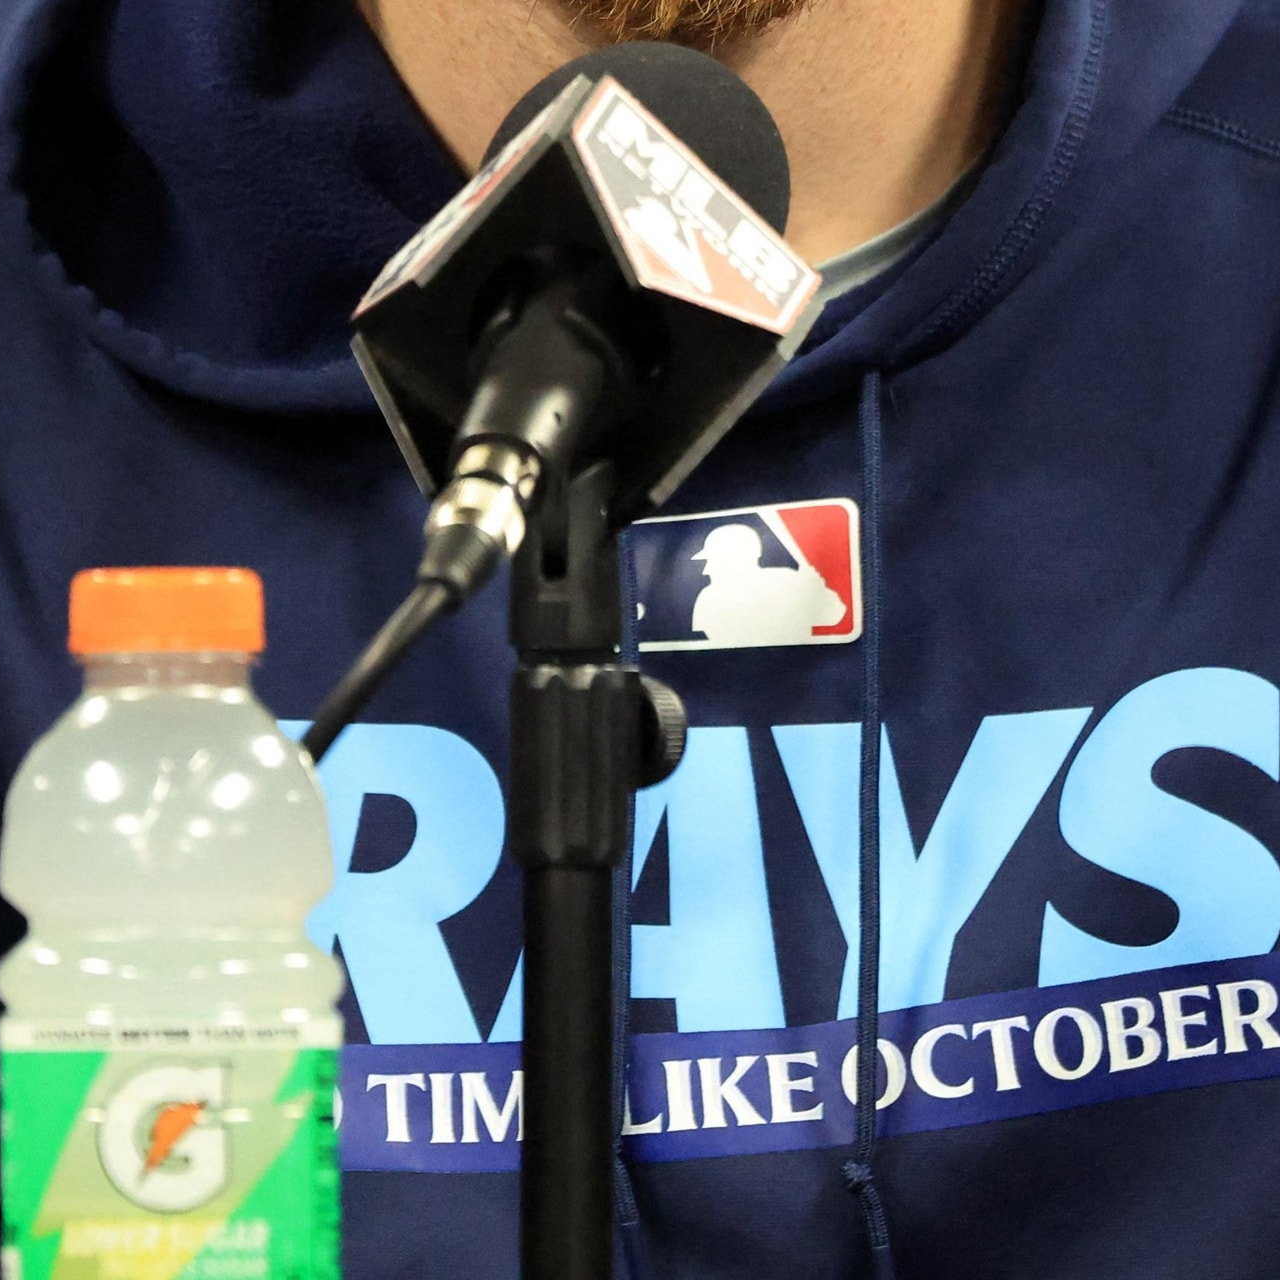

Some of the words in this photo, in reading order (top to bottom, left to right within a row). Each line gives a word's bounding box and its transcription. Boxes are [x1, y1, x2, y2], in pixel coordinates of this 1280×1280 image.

[602, 102, 800, 297] MLB
[366, 1070, 524, 1143] TIM
[621, 1051, 823, 1135] LIKE
